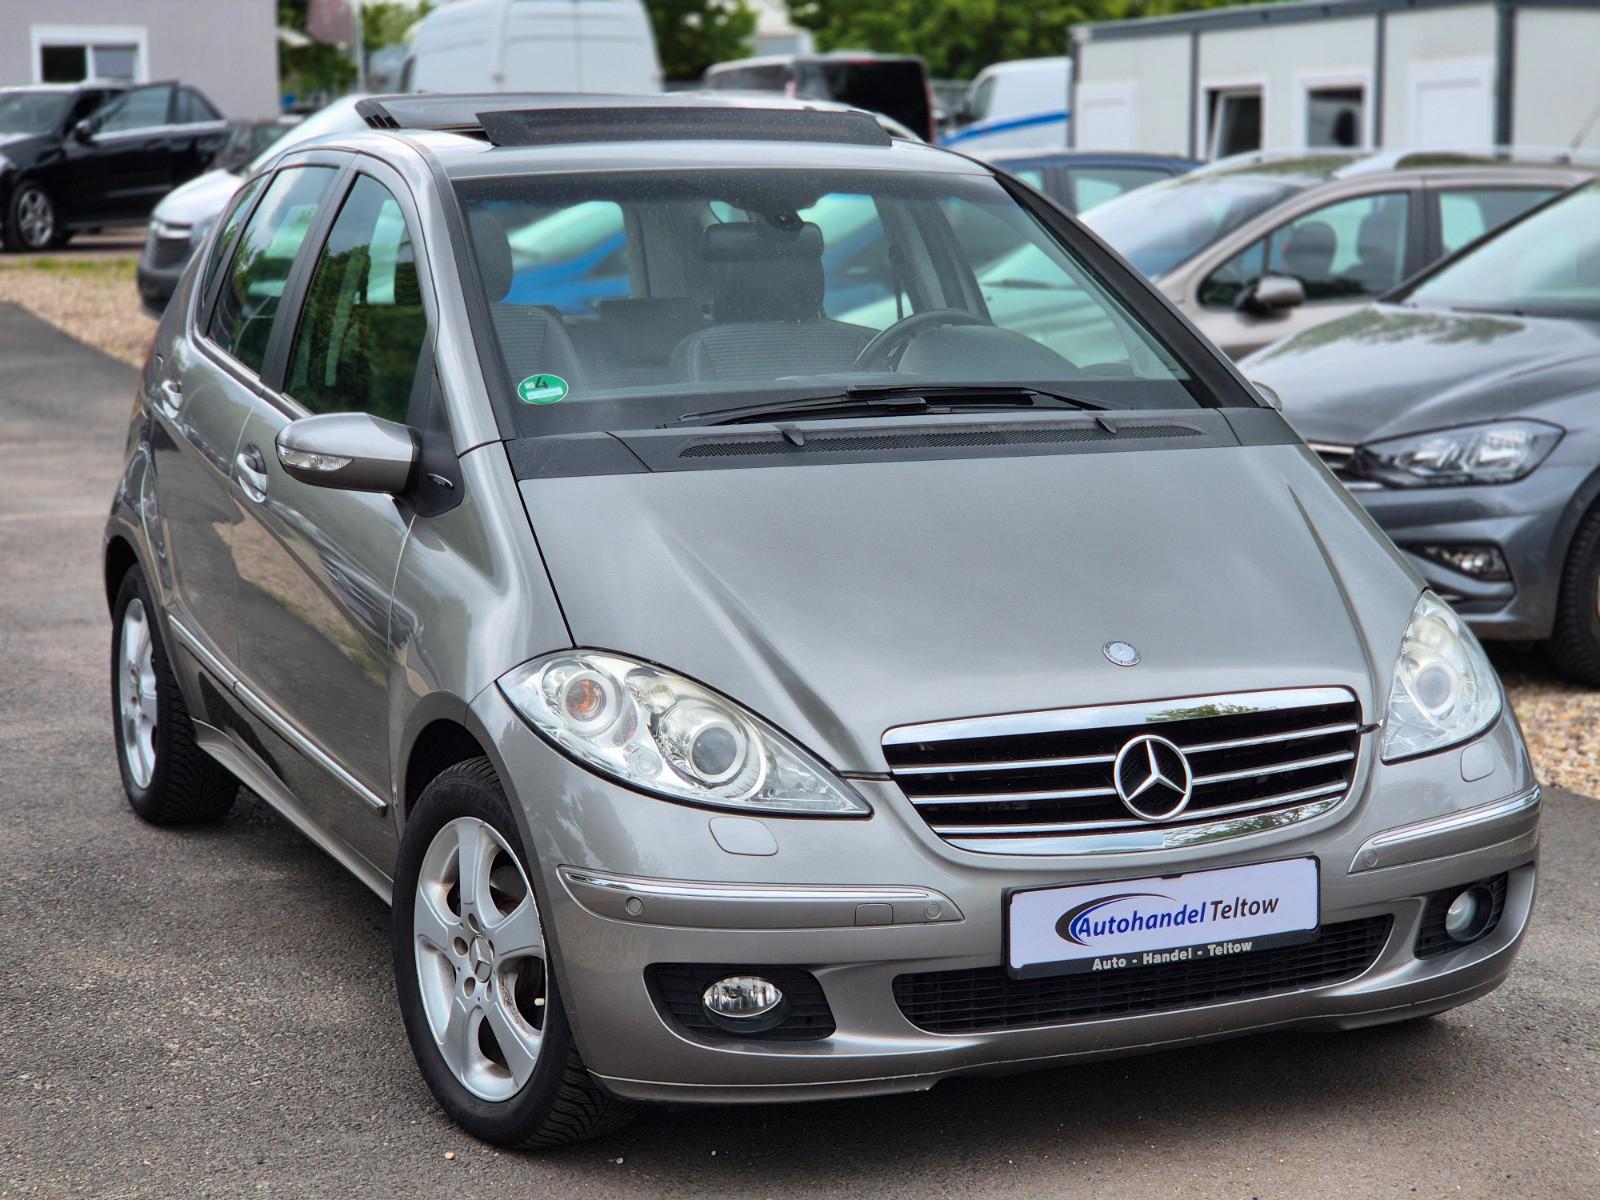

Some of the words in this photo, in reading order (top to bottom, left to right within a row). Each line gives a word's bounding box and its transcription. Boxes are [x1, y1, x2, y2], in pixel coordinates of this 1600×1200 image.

[1078, 901, 1207, 938] Autohandel
[1210, 896, 1280, 922] Teltow
[1092, 956, 1127, 971] Auto
[1142, 947, 1192, 965] Handel
[1207, 941, 1253, 957] Teltow
